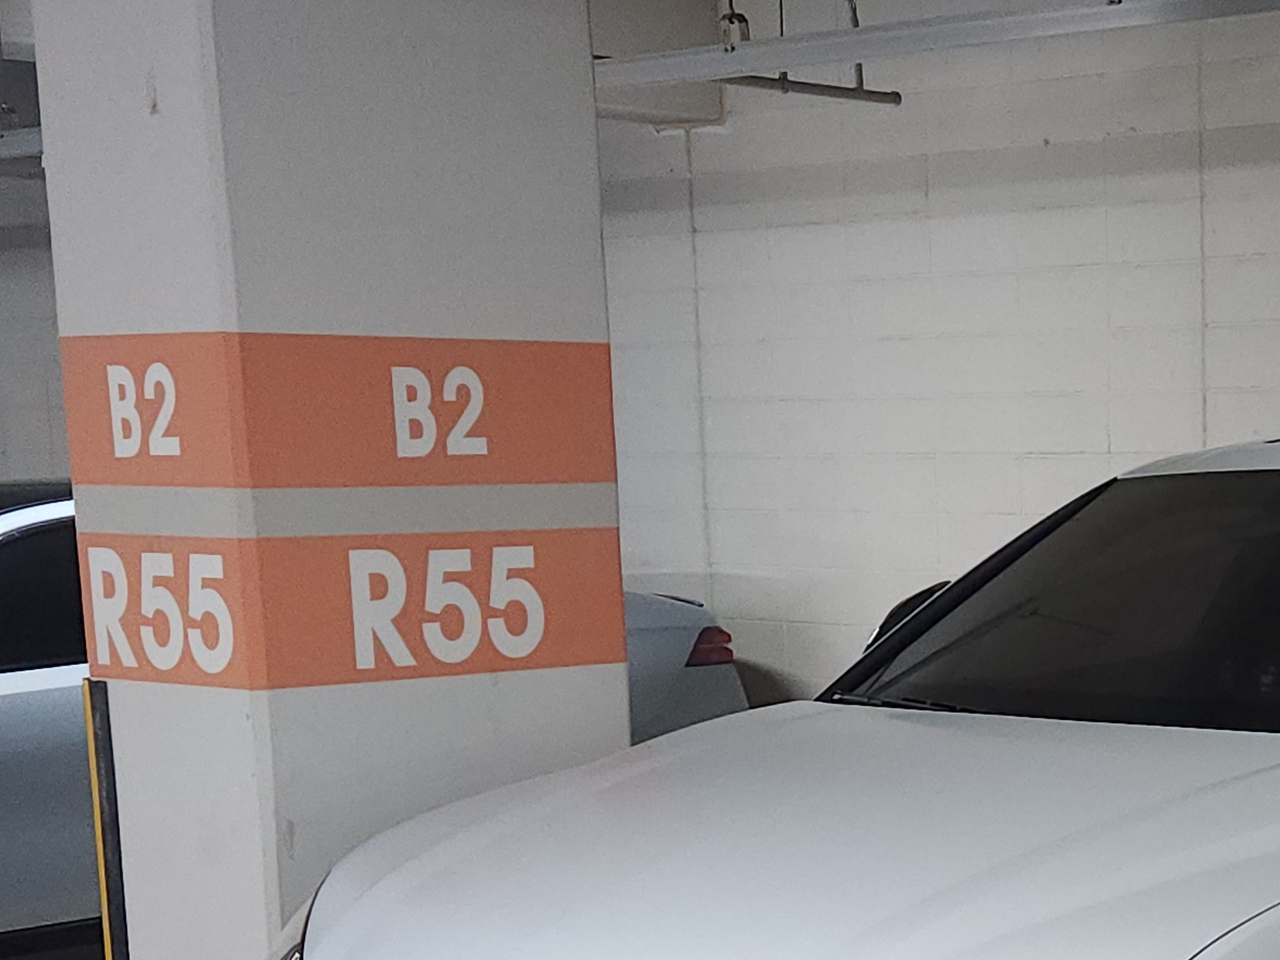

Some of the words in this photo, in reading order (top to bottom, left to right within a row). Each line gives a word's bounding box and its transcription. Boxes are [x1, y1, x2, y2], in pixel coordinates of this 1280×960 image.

[106, 362, 181, 459] B2
[390, 365, 488, 459] B2
[87, 546, 234, 674] R55
[348, 545, 545, 671] R55
